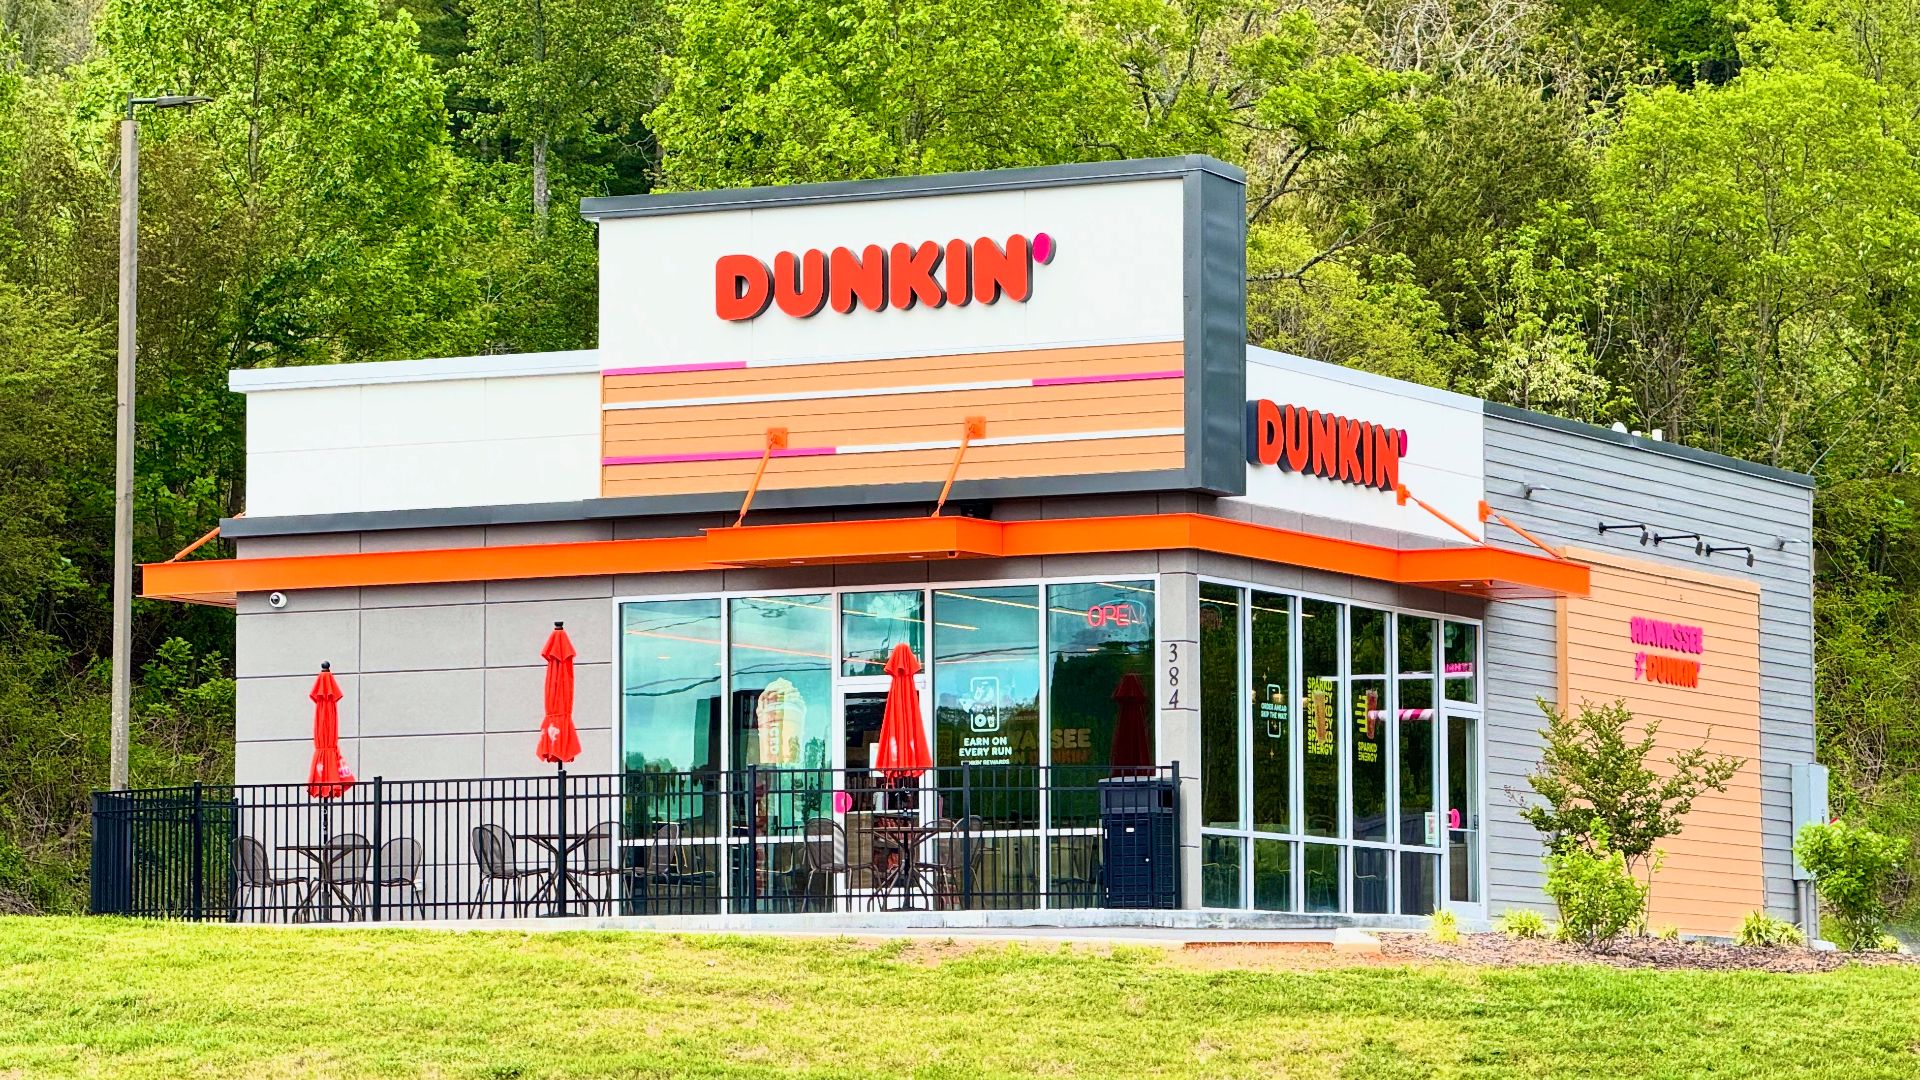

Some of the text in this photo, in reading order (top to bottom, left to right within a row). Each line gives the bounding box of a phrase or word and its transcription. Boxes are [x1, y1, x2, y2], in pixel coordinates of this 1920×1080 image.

[716, 233, 1052, 322] DUNKIN'
[1254, 398, 1408, 492] DUNKIN'
[1087, 604, 1144, 627] OPEN
[958, 746, 1013, 757] EVERY RUN
[963, 736, 1008, 746] EARN ON
